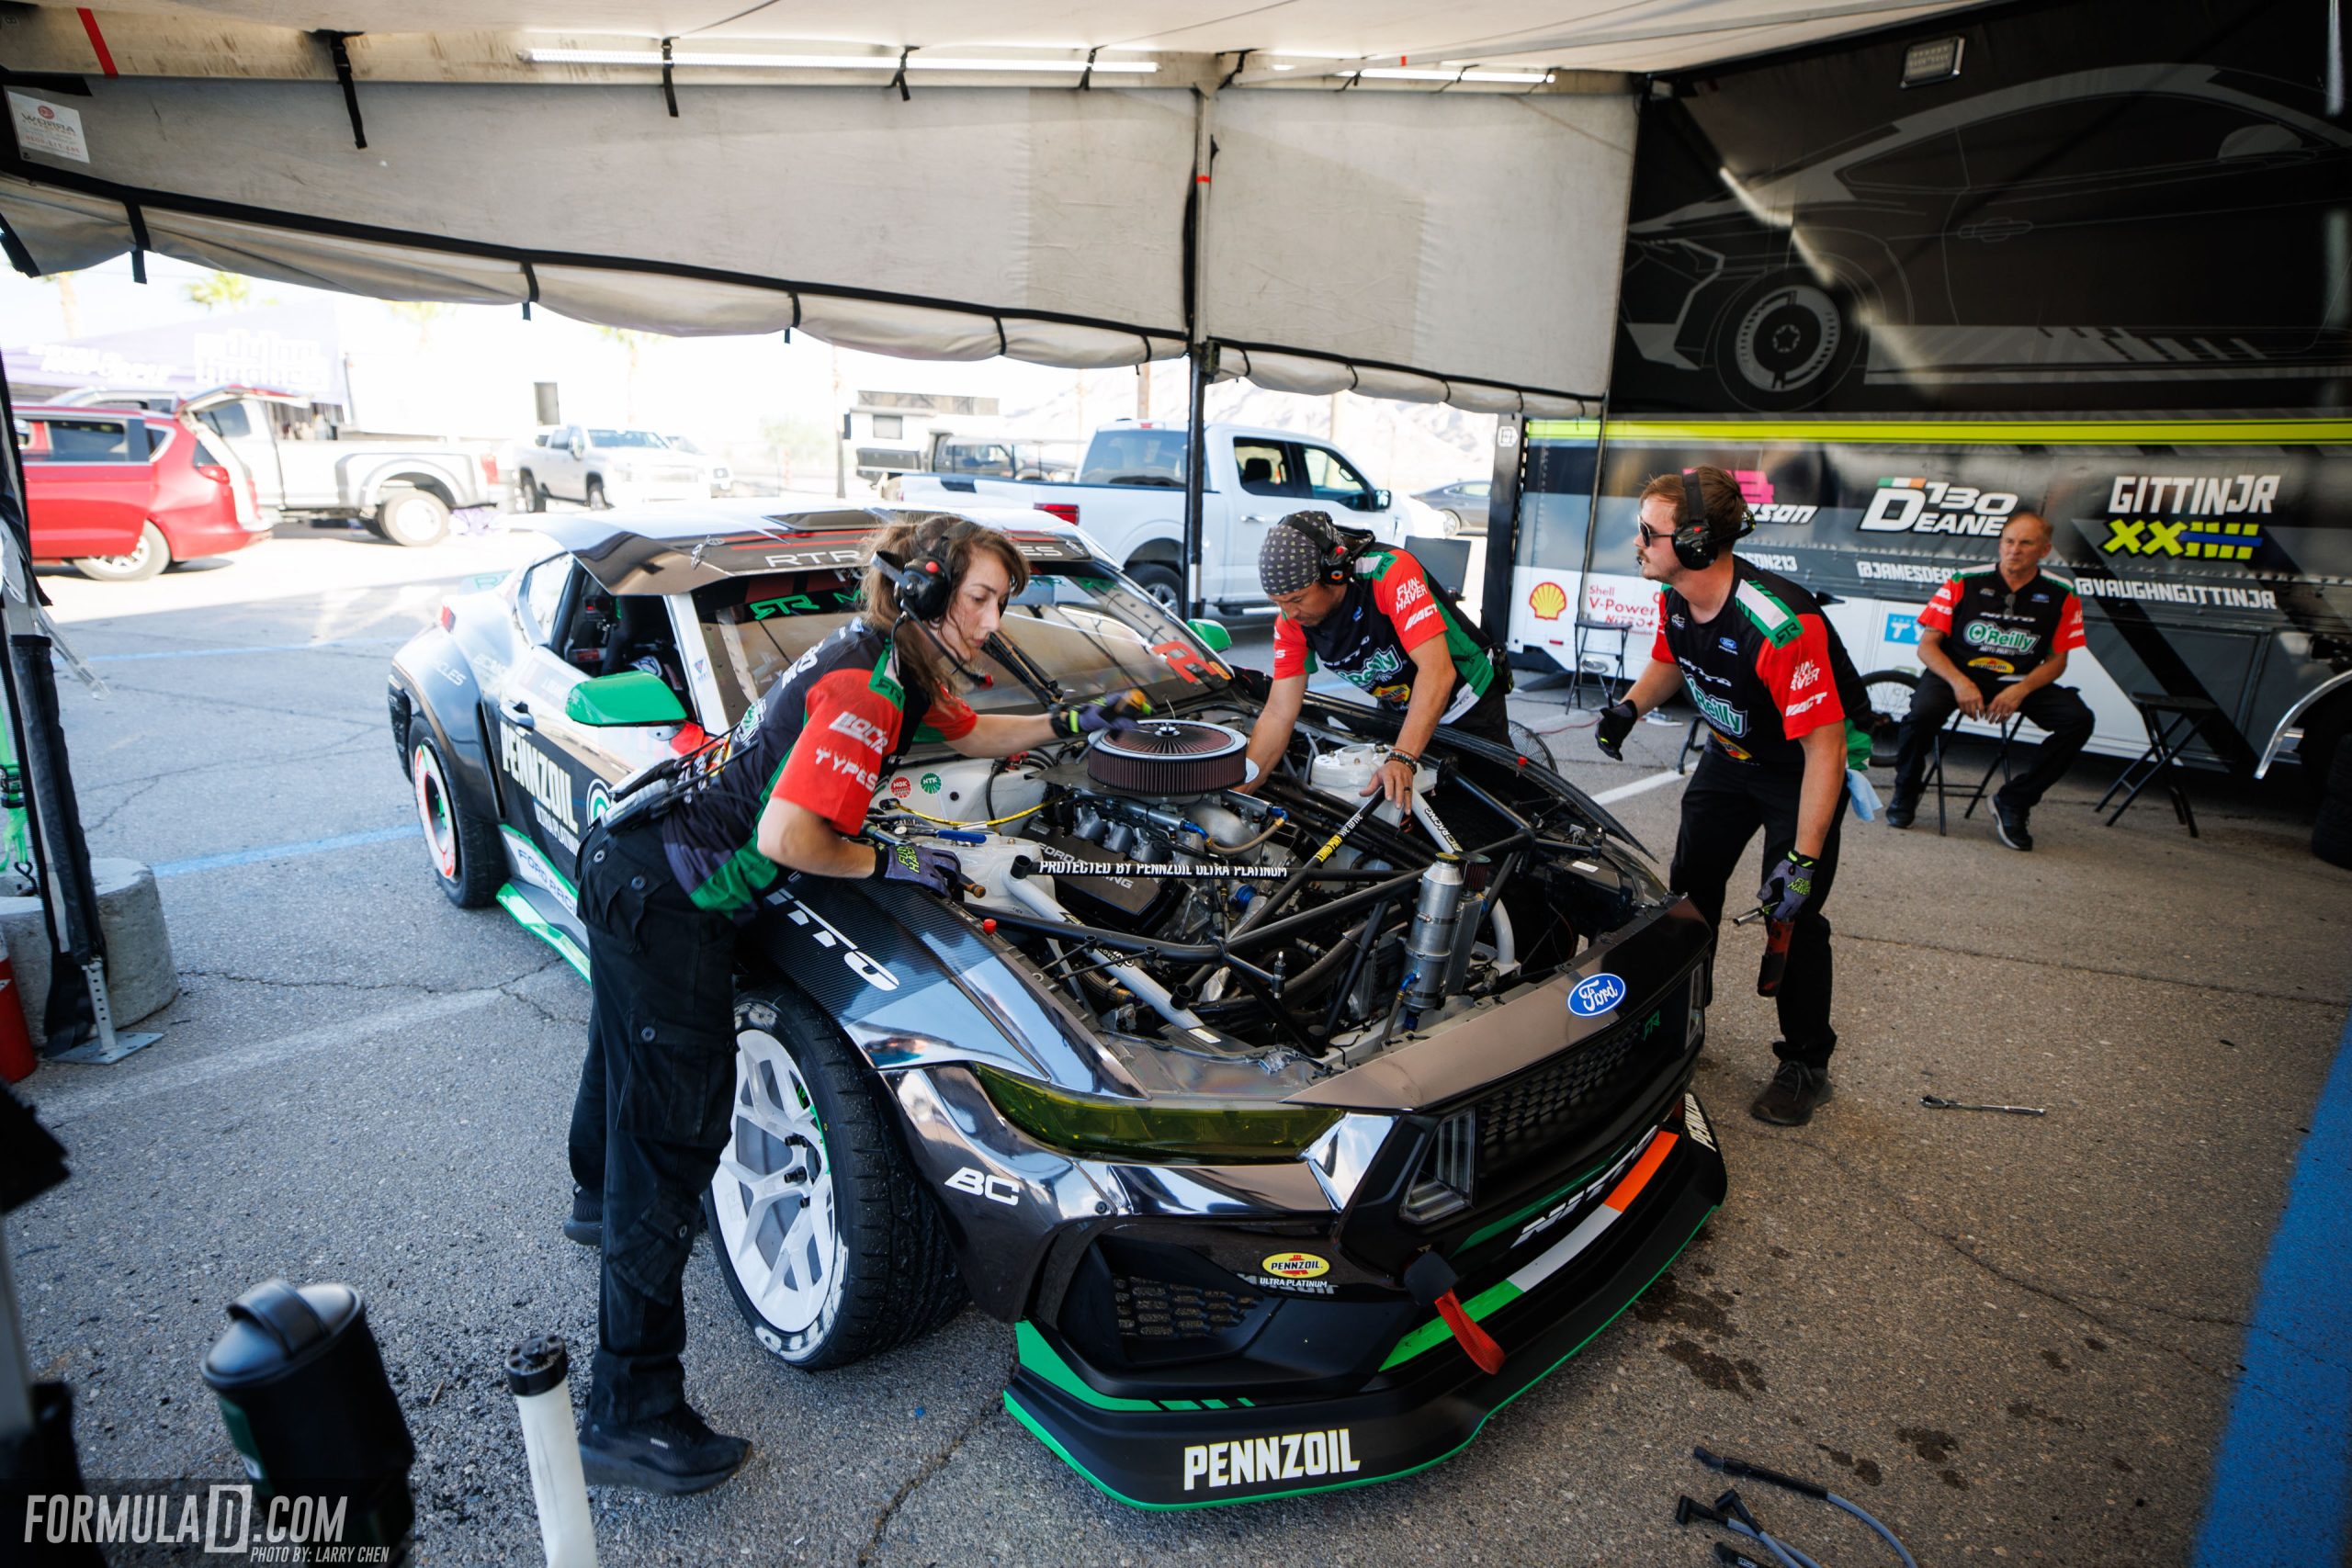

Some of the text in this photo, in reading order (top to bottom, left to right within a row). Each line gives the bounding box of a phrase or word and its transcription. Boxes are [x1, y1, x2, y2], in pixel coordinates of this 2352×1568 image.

[1925, 481, 2018, 515] 130
[2108, 475, 2281, 515] GITTINJR
[1860, 488, 2008, 536] DEANE
[1856, 560, 1959, 584] @JAMESDEA
[1396, 585, 1428, 614] HAVER
[1589, 585, 1614, 596] Shell
[1589, 596, 1656, 615] V-Power
[2075, 577, 2278, 610] @VAUGHNGITTINJR
[1967, 623, 2037, 652] O'Reilly
[500, 720, 579, 835] PENNZOIL
[1578, 979, 1619, 1011] Ford
[944, 1166, 1020, 1206] BC
[1271, 1261, 1319, 1270] PENNZOIL
[1260, 1278, 1285, 1286] ULTRA
[1286, 1279, 1328, 1288] PLATINUM
[1183, 1428, 1361, 1492] PENNZOIL
